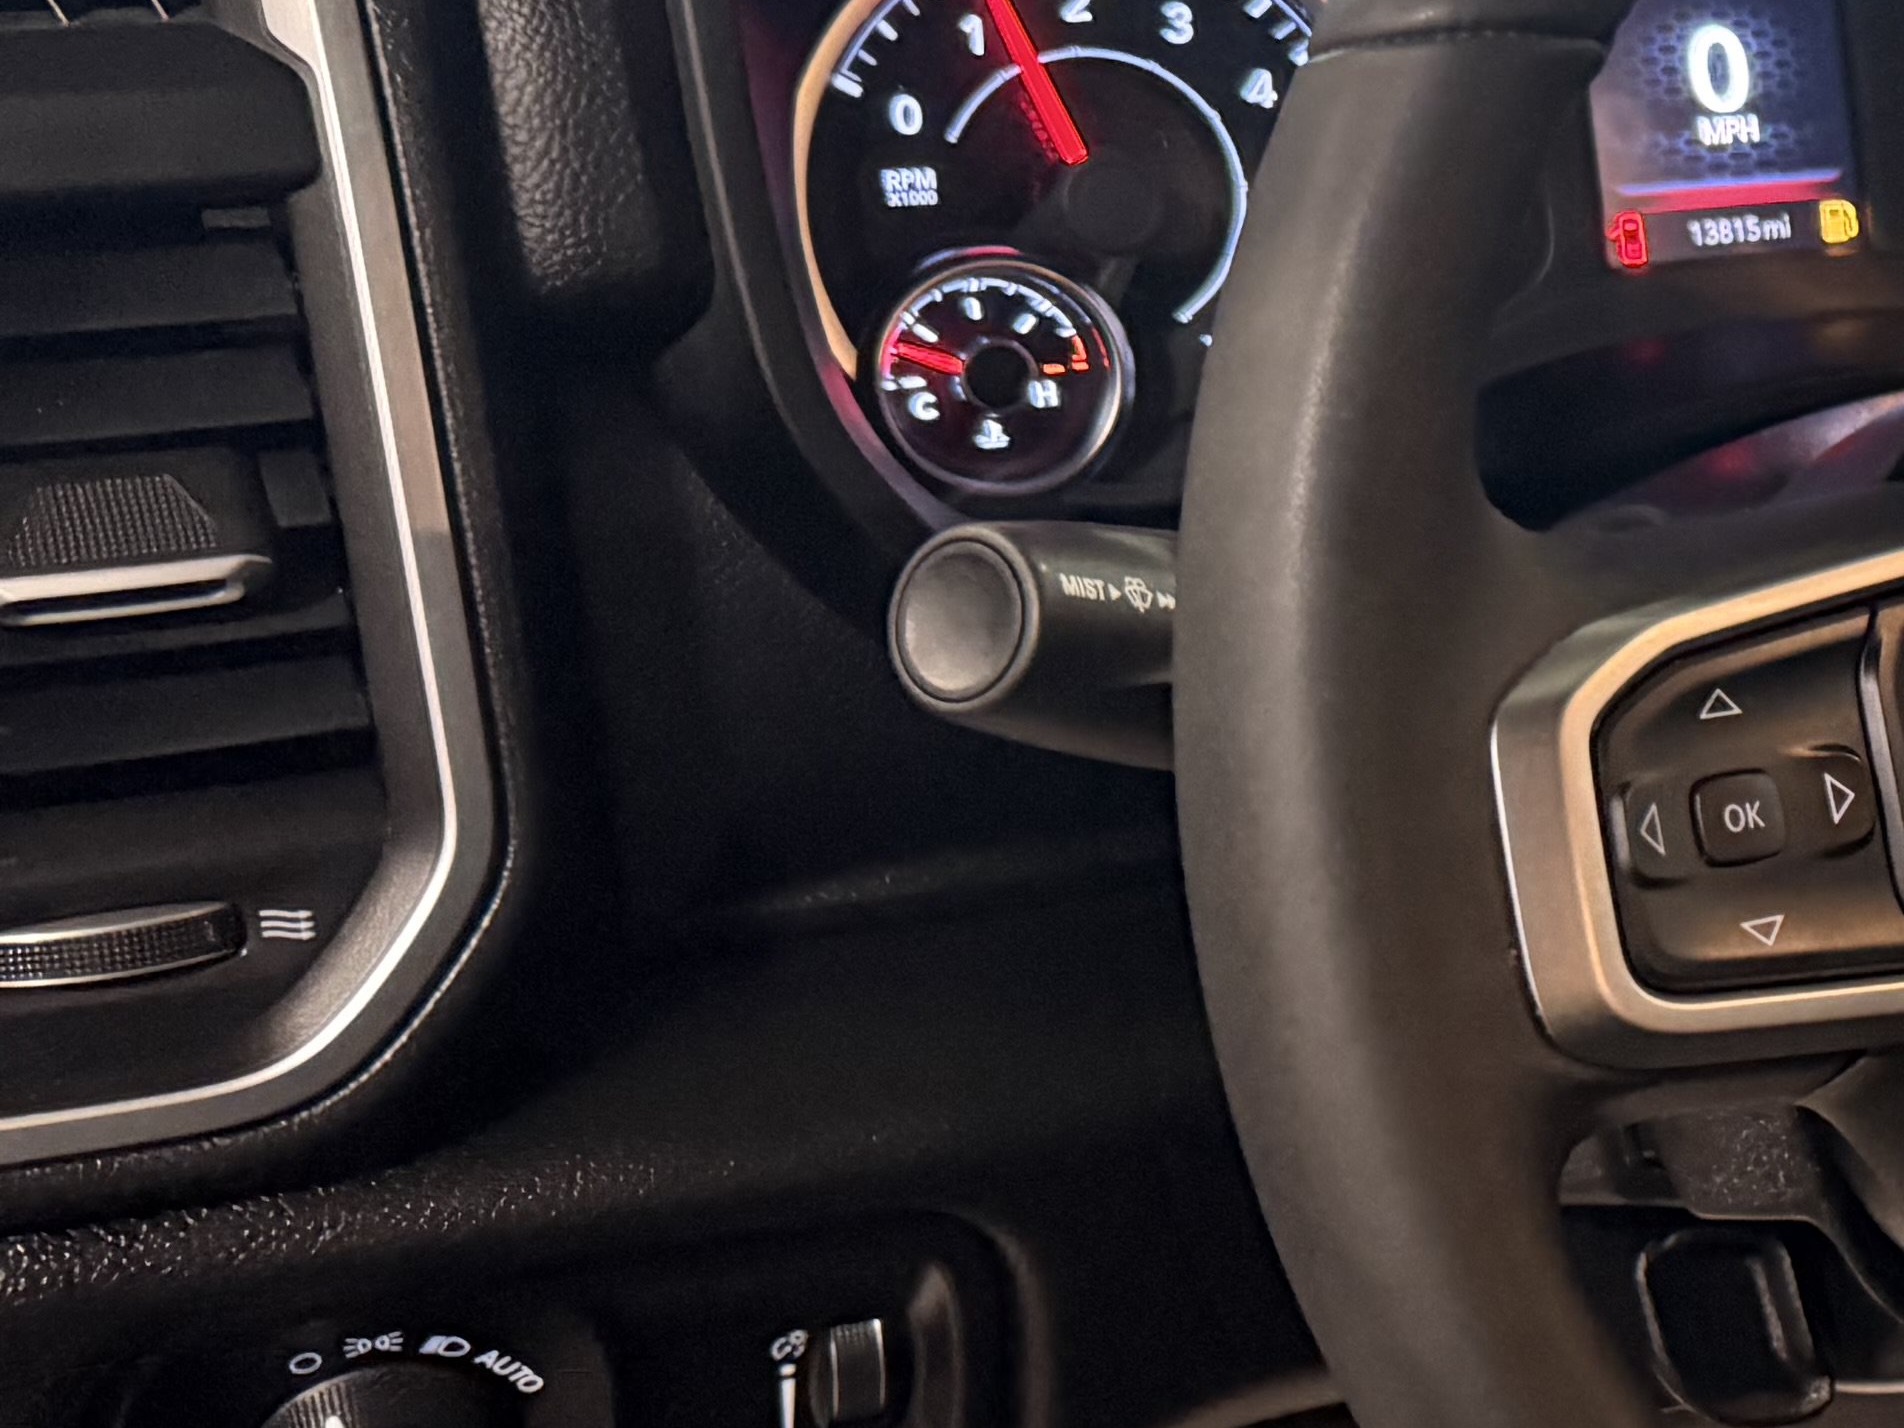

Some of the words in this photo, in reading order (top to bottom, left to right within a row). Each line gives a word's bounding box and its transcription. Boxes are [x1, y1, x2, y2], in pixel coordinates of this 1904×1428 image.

[956, 13, 985, 56] 1
[1159, 0, 1194, 44] 3
[1687, 24, 1750, 113] 0
[1239, 68, 1278, 109] 4
[887, 92, 923, 136] 0
[1696, 113, 1761, 147] MPH
[880, 166, 938, 191] RPM
[907, 391, 941, 421] C
[1028, 379, 1059, 408] H
[1060, 572, 1106, 601] MIST
[1723, 799, 1765, 833] OK
[473, 1349, 544, 1393] AUTO
